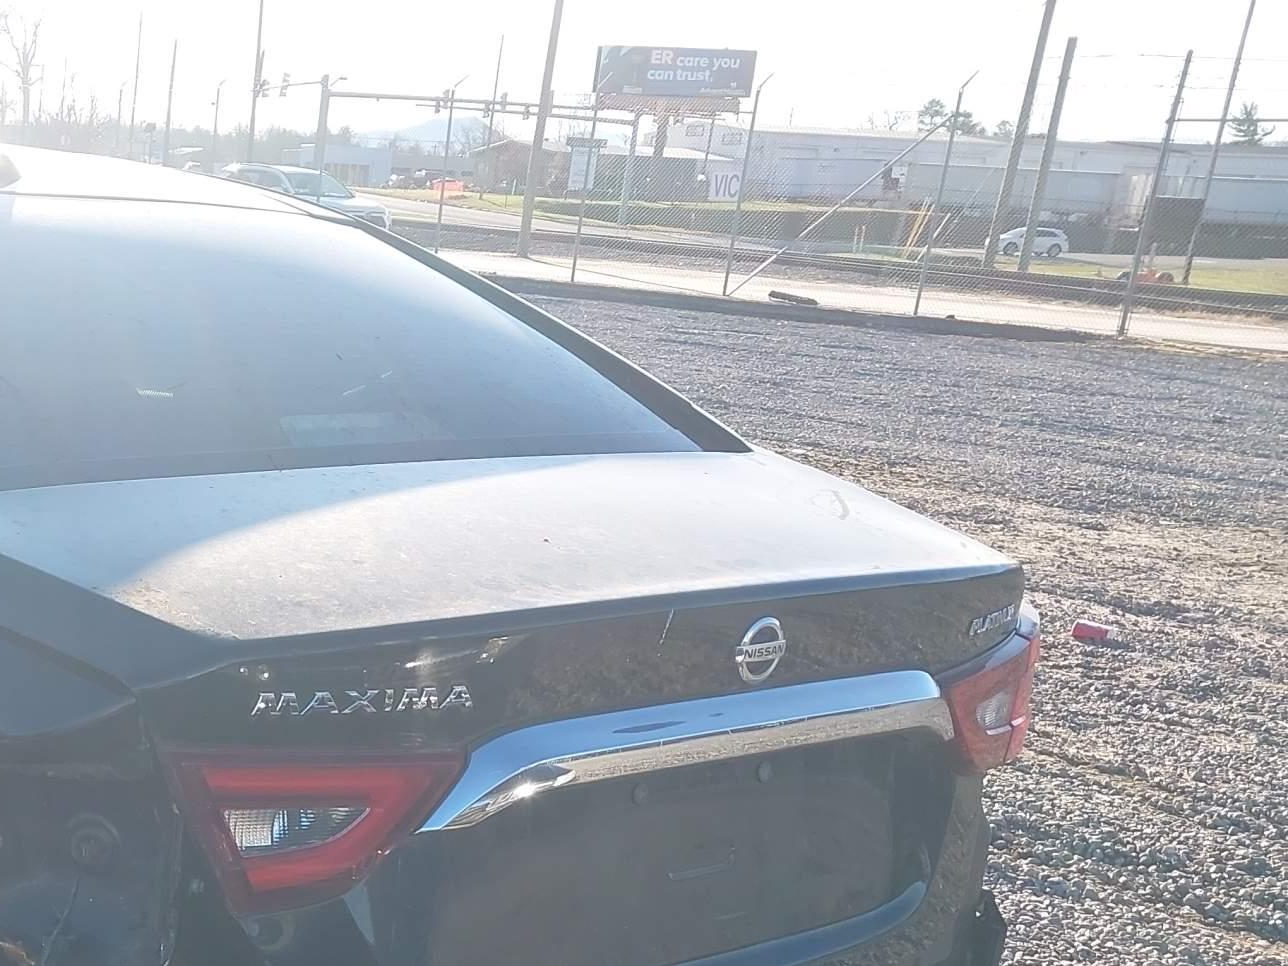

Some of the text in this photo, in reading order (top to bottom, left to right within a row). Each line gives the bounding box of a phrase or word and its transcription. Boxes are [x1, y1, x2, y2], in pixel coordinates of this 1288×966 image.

[651, 50, 740, 69] ER care you
[647, 68, 673, 81] can
[744, 644, 784, 659] NISSAN
[250, 685, 473, 716] MAXIMA
